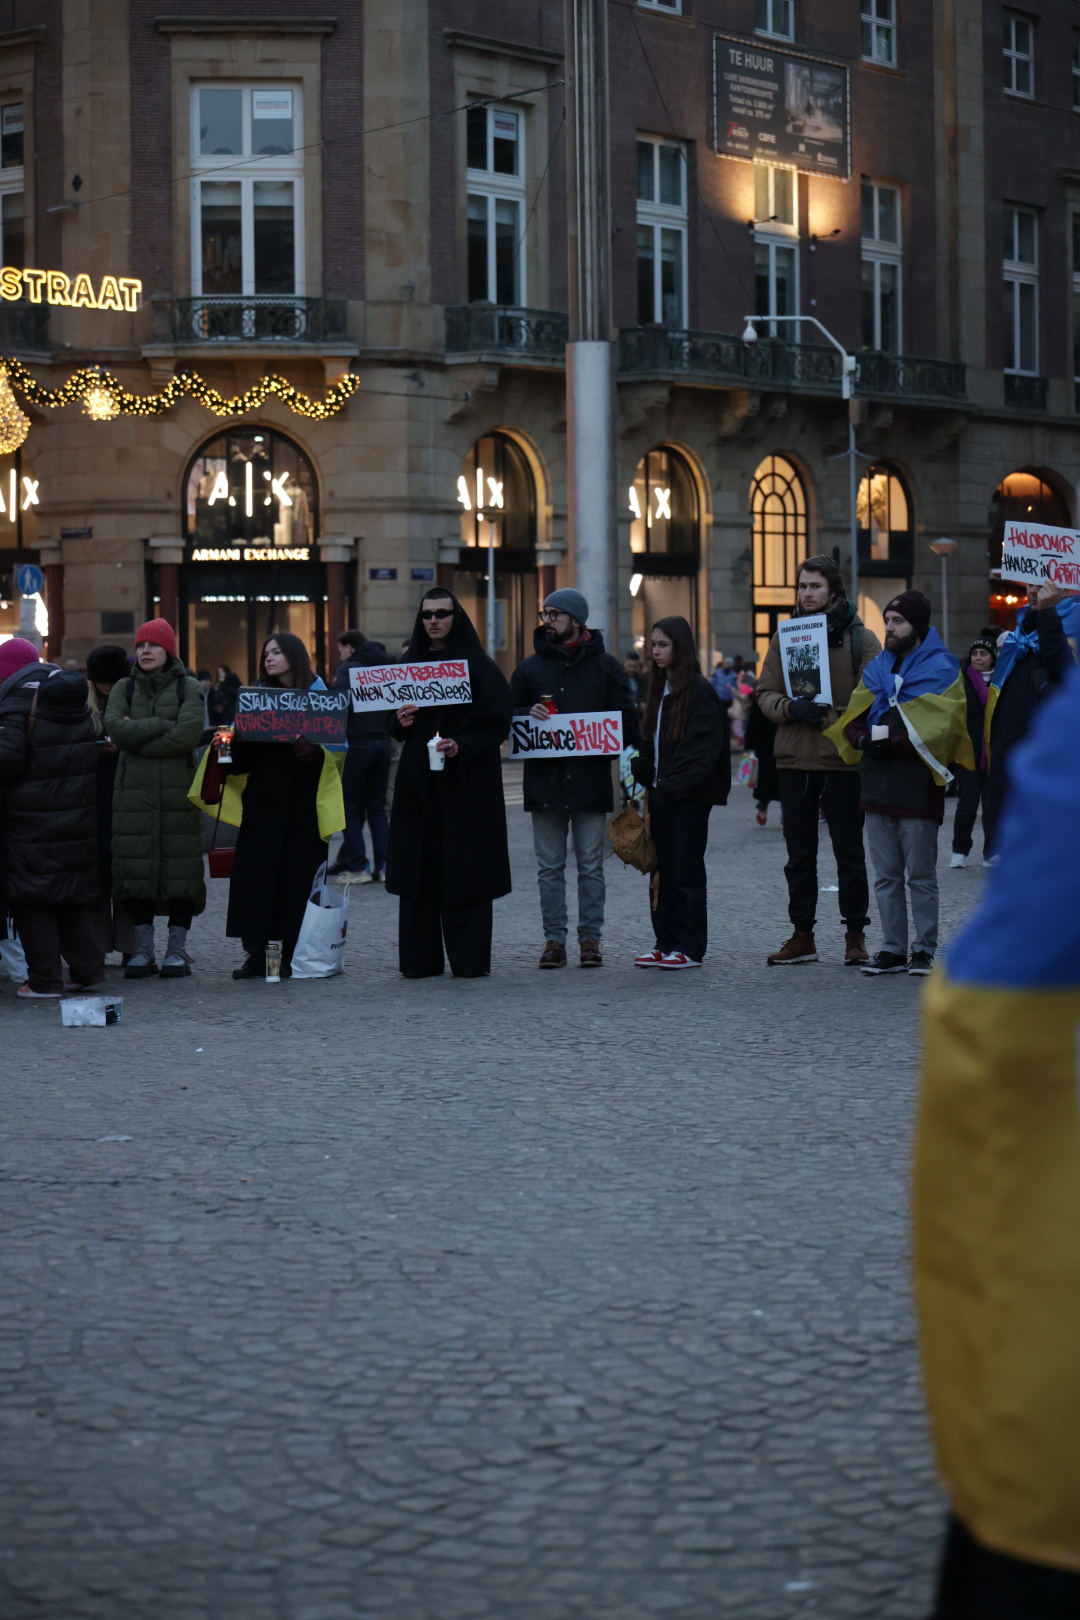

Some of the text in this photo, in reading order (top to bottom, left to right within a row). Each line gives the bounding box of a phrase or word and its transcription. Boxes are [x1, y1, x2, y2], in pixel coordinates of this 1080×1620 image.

[729, 49, 774, 73] TE HUUR
[0, 266, 142, 312] STRAAT
[1008, 527, 1075, 555] HOLODOMOR
[191, 548, 310, 561] ARMANI EXCHANGE
[781, 622, 823, 634] UKRAINIAN CHILDREN
[790, 635, 812, 644] 1932-1933
[308, 692, 348, 712] BREAD
